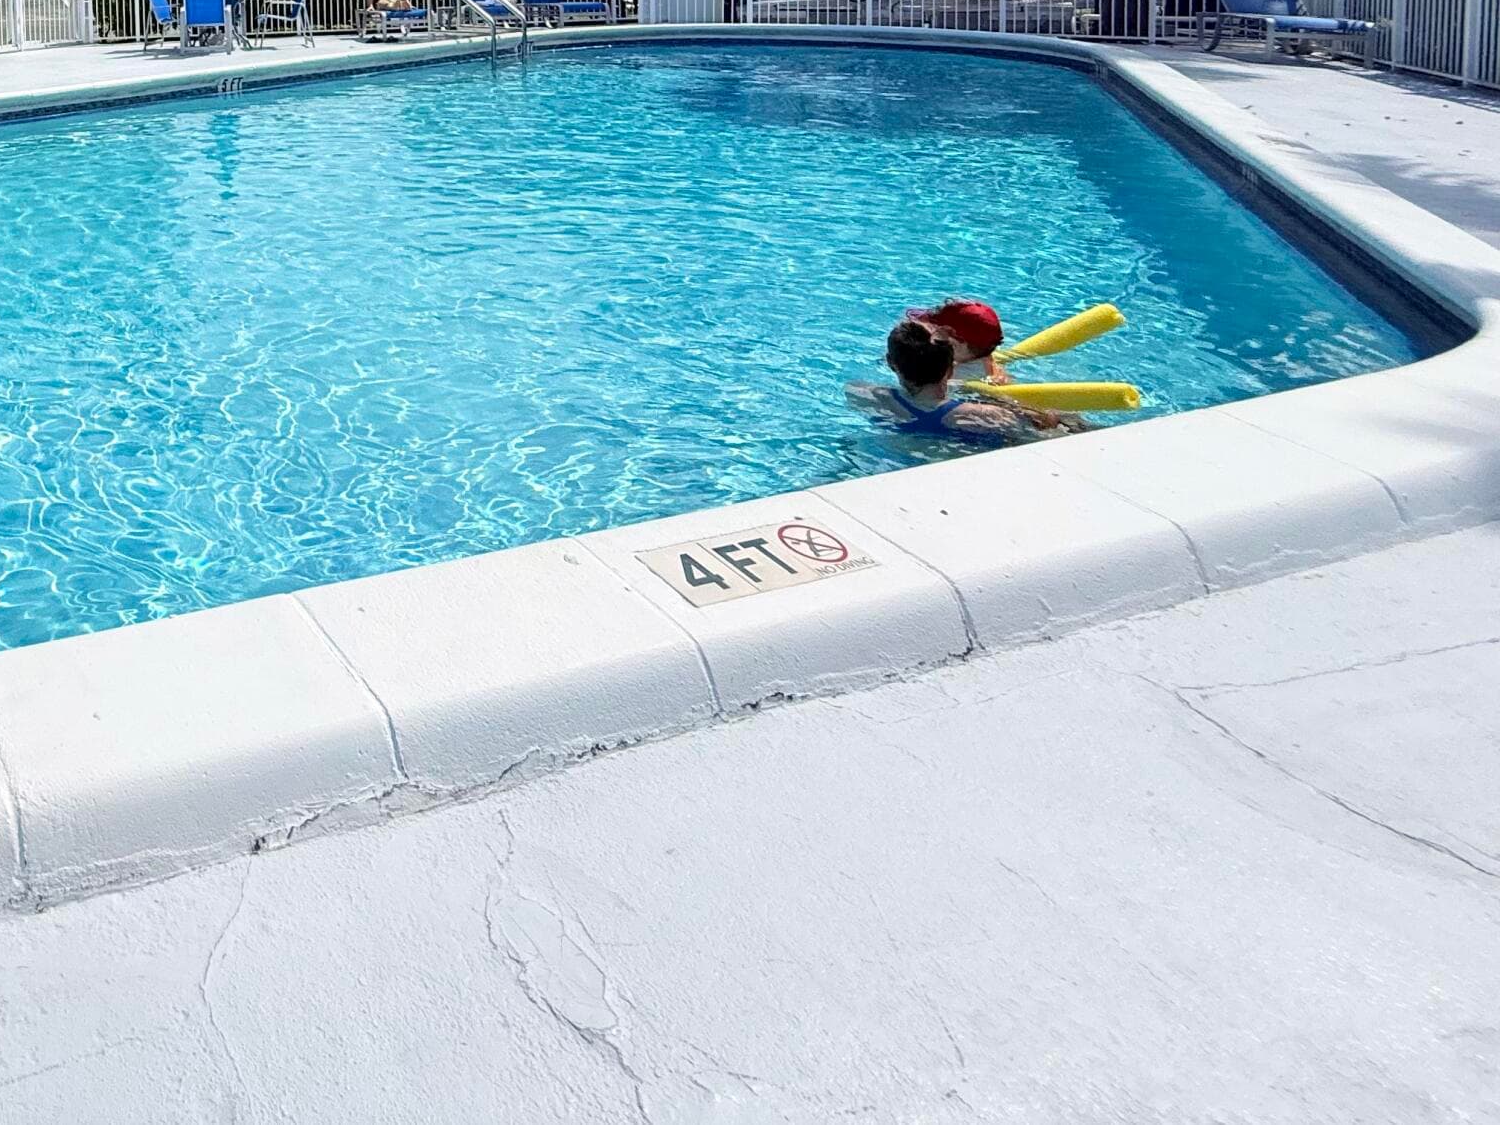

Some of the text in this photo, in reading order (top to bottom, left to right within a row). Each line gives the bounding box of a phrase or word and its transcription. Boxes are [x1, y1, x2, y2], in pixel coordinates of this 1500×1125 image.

[222, 77, 243, 92] 5 FT
[679, 537, 799, 590] 4 FT
[815, 556, 876, 576] NO DIVING
